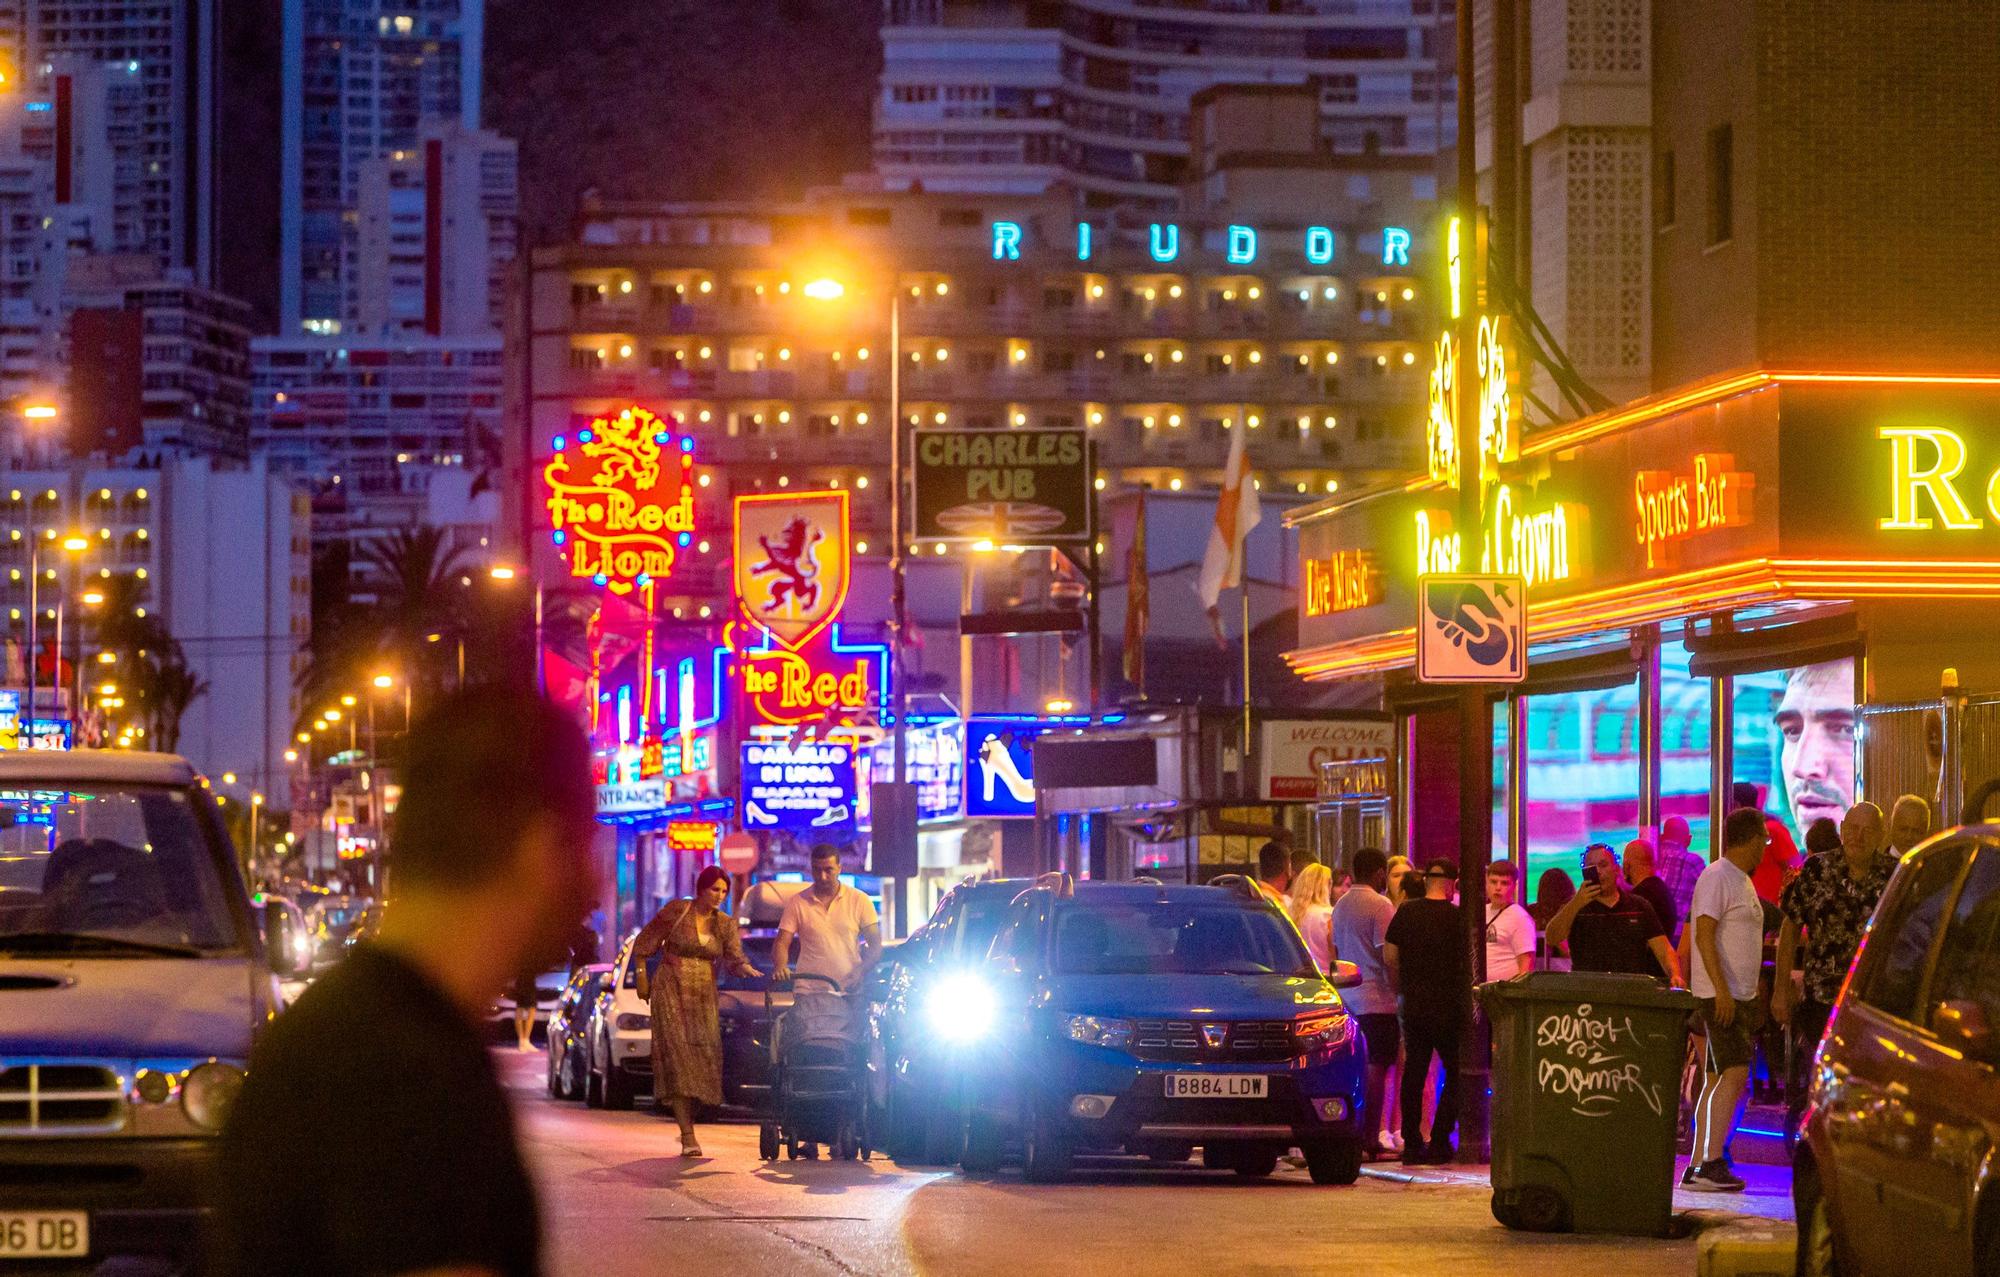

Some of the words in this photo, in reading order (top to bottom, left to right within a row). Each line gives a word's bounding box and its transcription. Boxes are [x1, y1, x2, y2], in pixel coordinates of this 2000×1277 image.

[992, 222, 1411, 265] RIUDOR
[920, 434, 1082, 466] CHARLES
[967, 468, 1037, 499] PUB
[1876, 426, 2000, 531] R
[547, 493, 604, 528] The
[606, 493, 695, 531] Red
[1634, 472, 1689, 569] Sports
[1694, 454, 1729, 530] Bar
[1415, 510, 1460, 575] Rose
[1495, 485, 1568, 586] Crown
[572, 541, 671, 577] Lion
[1306, 558, 1331, 617] Live
[1332, 549, 1369, 612] Music
[740, 663, 778, 693] he
[780, 659, 869, 708] Red
[1291, 727, 1386, 741] WELCOME
[1178, 1078, 1222, 1095] 8884
[1229, 1078, 1262, 1095] LDW
[0, 1218, 27, 1250] 6
[37, 1218, 78, 1250] DB
